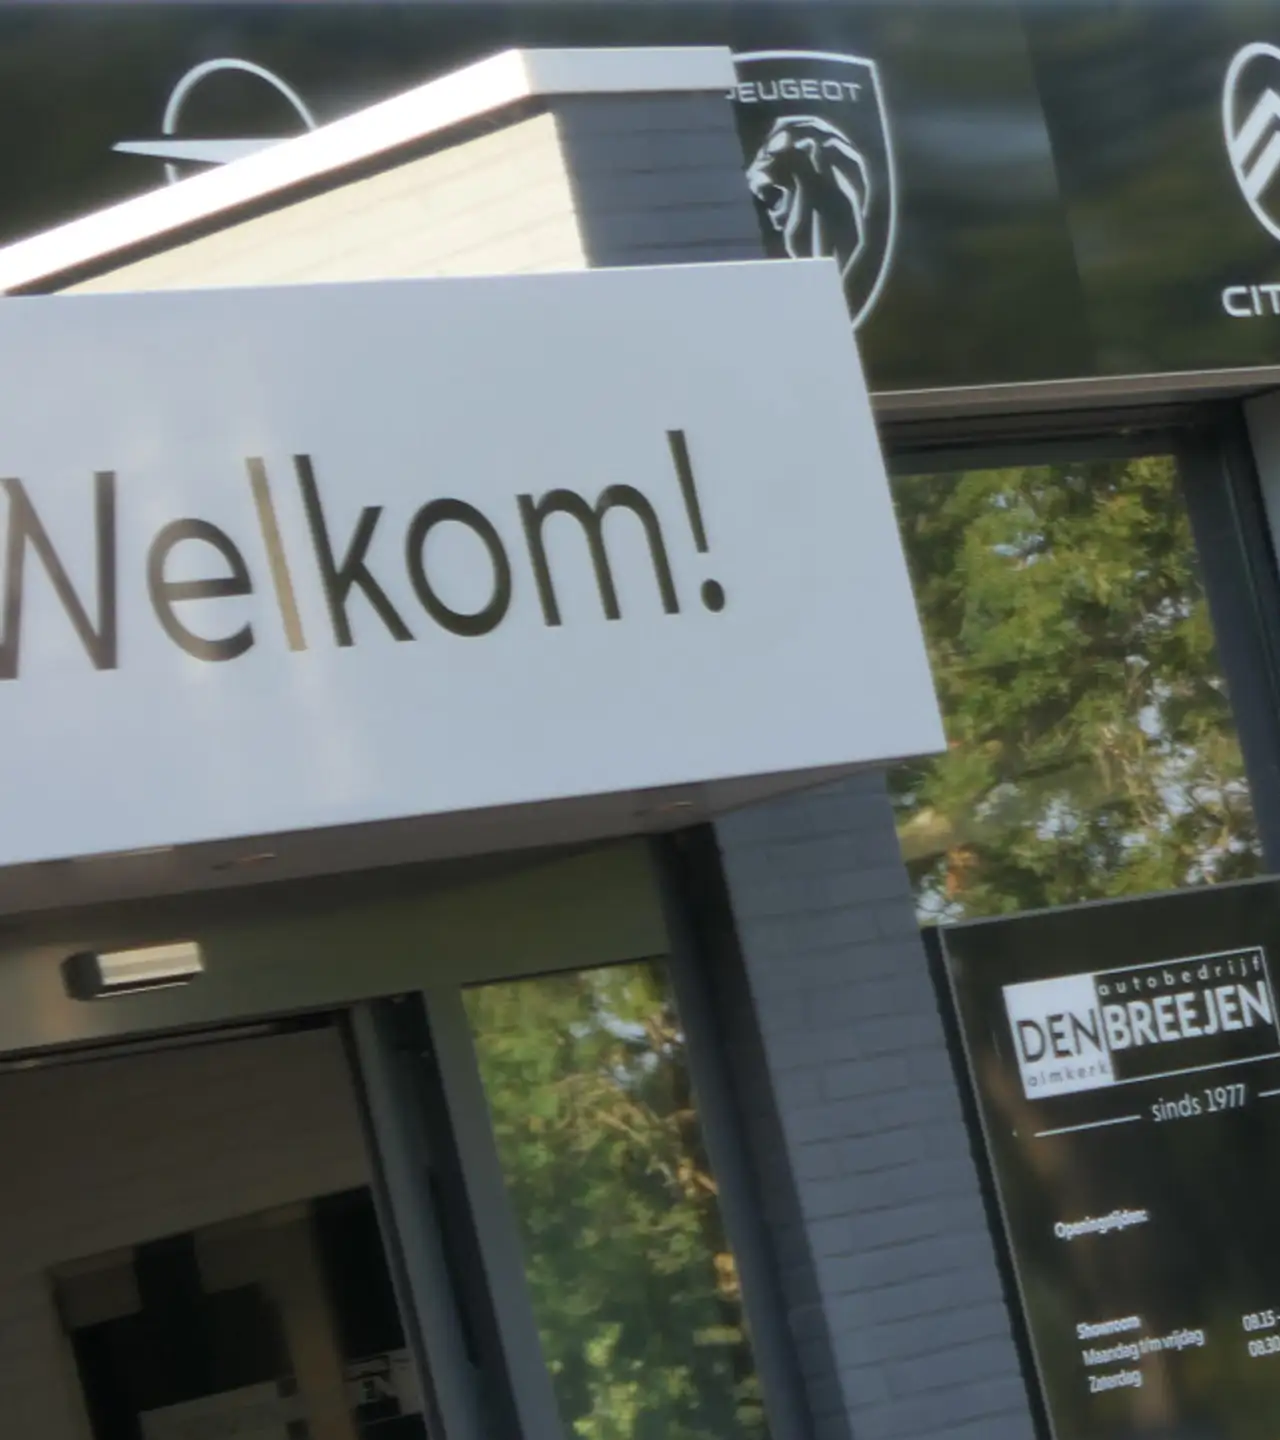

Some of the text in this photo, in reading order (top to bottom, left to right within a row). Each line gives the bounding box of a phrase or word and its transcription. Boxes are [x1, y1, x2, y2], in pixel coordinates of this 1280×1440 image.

[0, 429, 727, 681] Welkom!
[1098, 955, 1262, 996] autobedrijf
[1027, 1062, 1110, 1088] almkerk
[1152, 1083, 1247, 1123] sinds 1977
